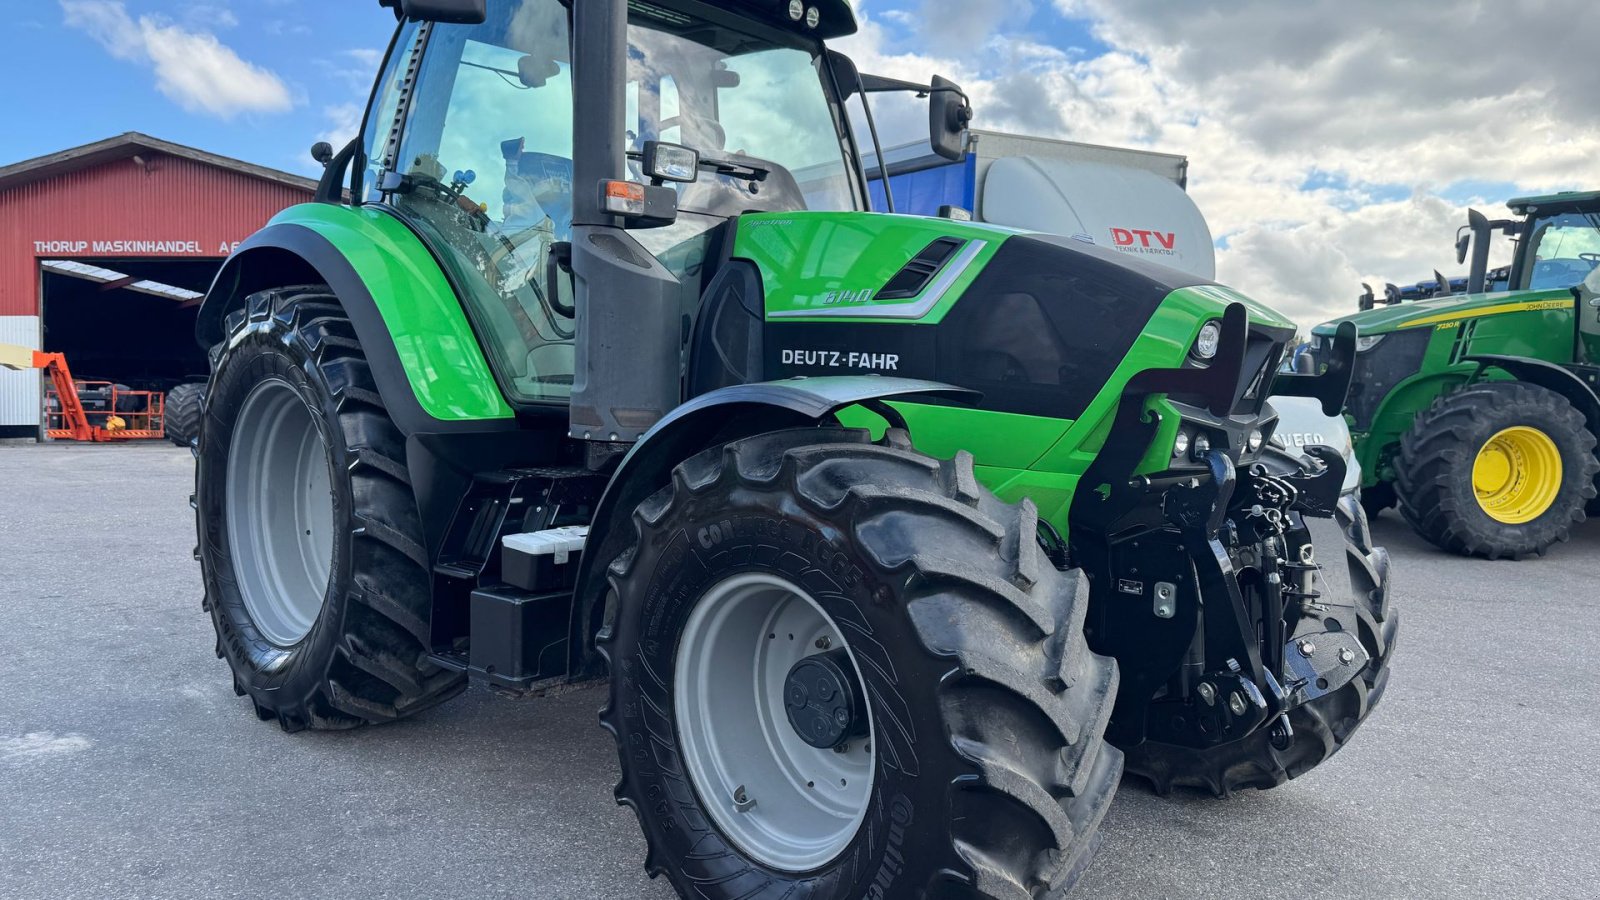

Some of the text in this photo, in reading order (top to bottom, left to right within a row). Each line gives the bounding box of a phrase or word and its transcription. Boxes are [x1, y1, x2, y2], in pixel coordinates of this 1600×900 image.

[34, 240, 87, 253] THORUP
[92, 240, 203, 253] MASKINHANDEL
[1109, 228, 1175, 249] DTV
[822, 288, 874, 304] 6140
[1526, 301, 1564, 310] JOHN DEERE
[781, 349, 900, 370] DEUTZ-FAHR
